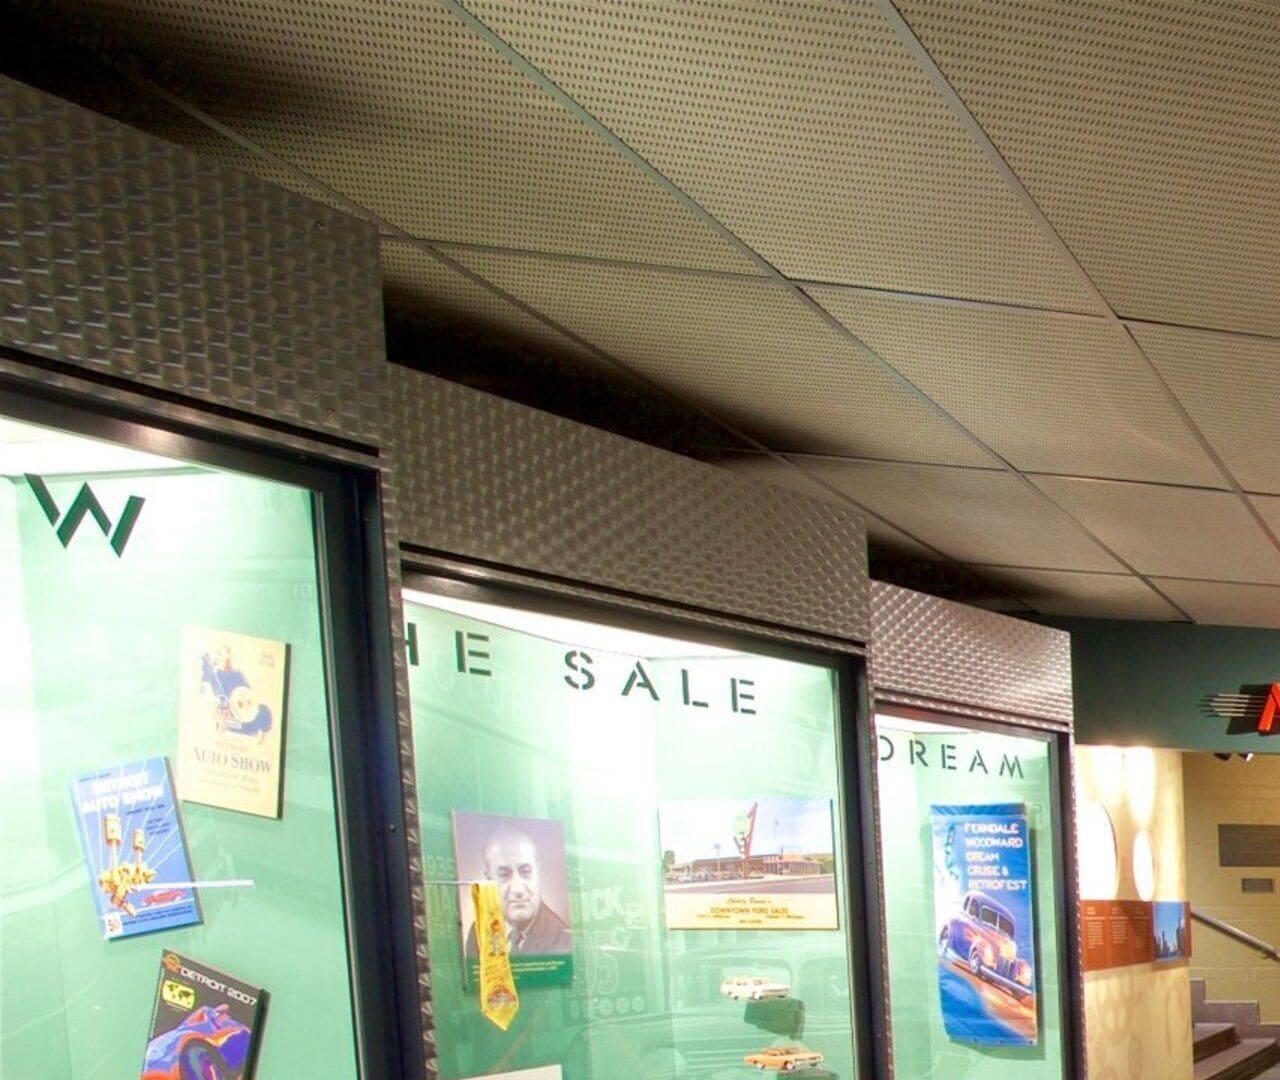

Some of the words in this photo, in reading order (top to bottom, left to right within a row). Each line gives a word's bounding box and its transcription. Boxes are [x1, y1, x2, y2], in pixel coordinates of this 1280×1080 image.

[563, 649, 757, 716] SALE
[231, 755, 272, 774] SHOW
[964, 836, 1024, 849] WOODWARD
[180, 965, 227, 994] DETROIT
[226, 986, 260, 1007] 2007
